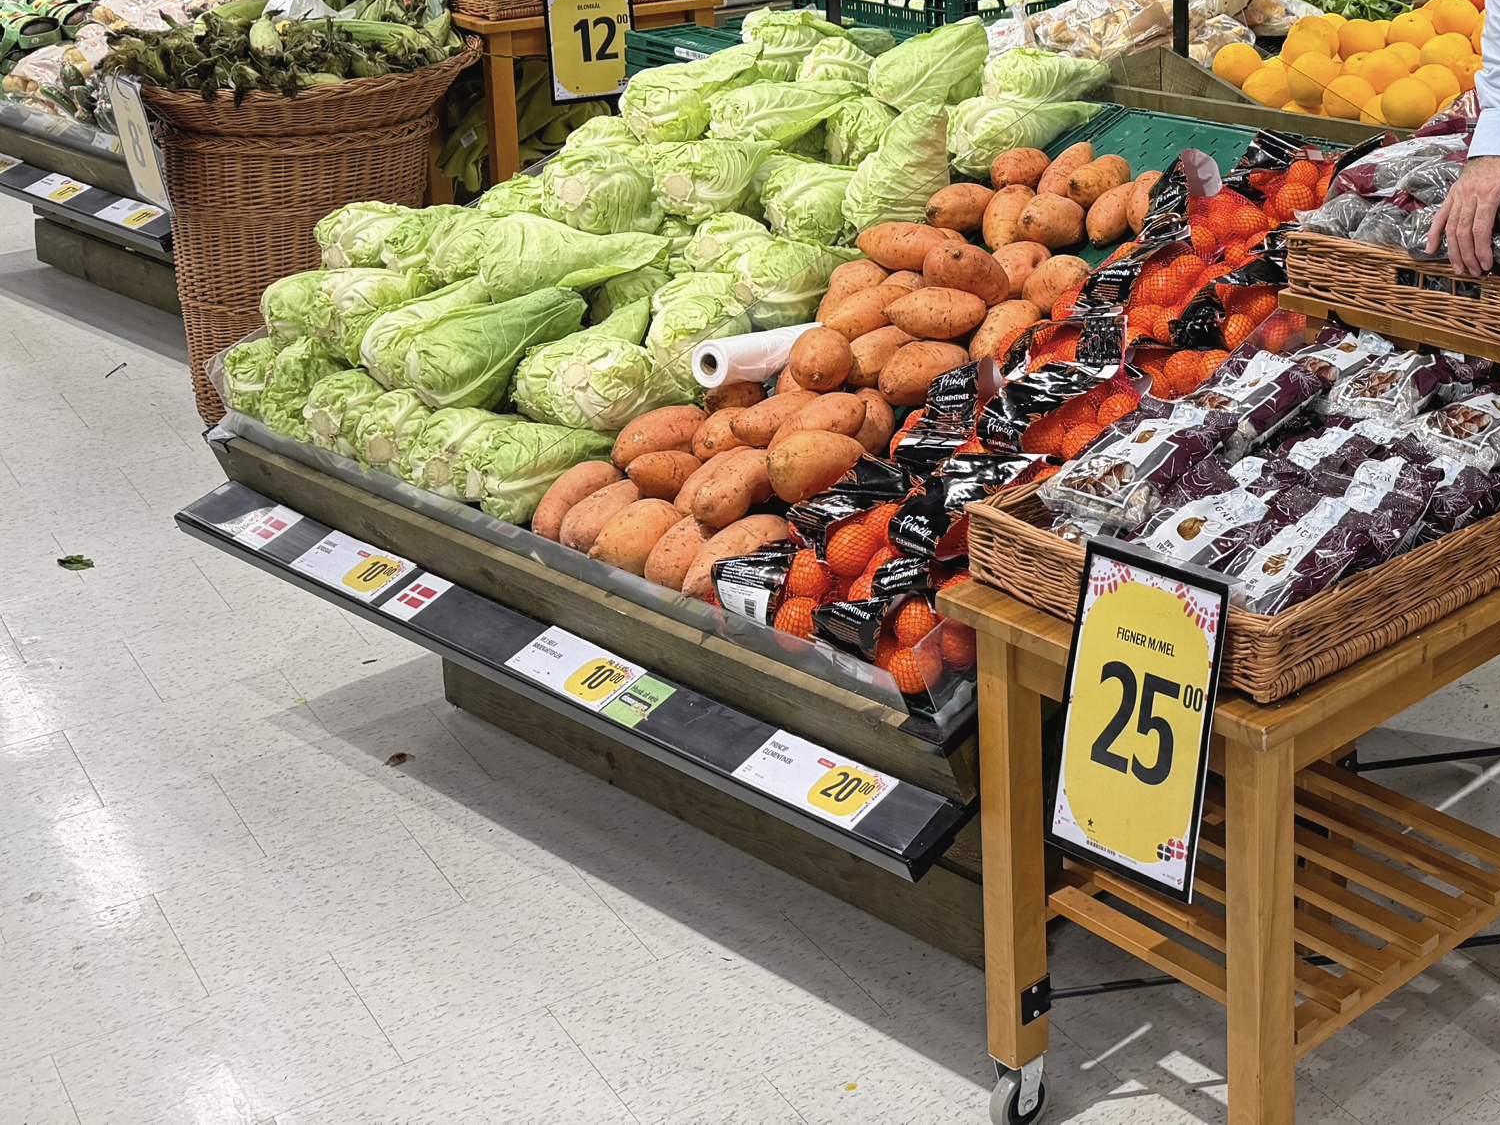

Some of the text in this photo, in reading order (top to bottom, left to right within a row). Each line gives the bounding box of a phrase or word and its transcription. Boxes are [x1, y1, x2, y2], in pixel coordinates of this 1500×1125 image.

[574, 16, 619, 62] 12
[940, 374, 968, 390] Princip
[936, 393, 969, 402] CLEMENTINER
[987, 417, 1014, 440] Princip
[899, 514, 932, 541] Princip
[356, 561, 388, 582] 10
[832, 601, 871, 620] EMENTINER
[1117, 626, 1175, 658] FIGNER M/MEL
[580, 665, 614, 690] 10
[630, 684, 644, 696] Husk
[642, 690, 650, 698] at
[1091, 661, 1181, 786] 25
[762, 747, 794, 765] CLEMENTINER
[769, 740, 790, 751] PRINCIP
[819, 772, 862, 803] 20
